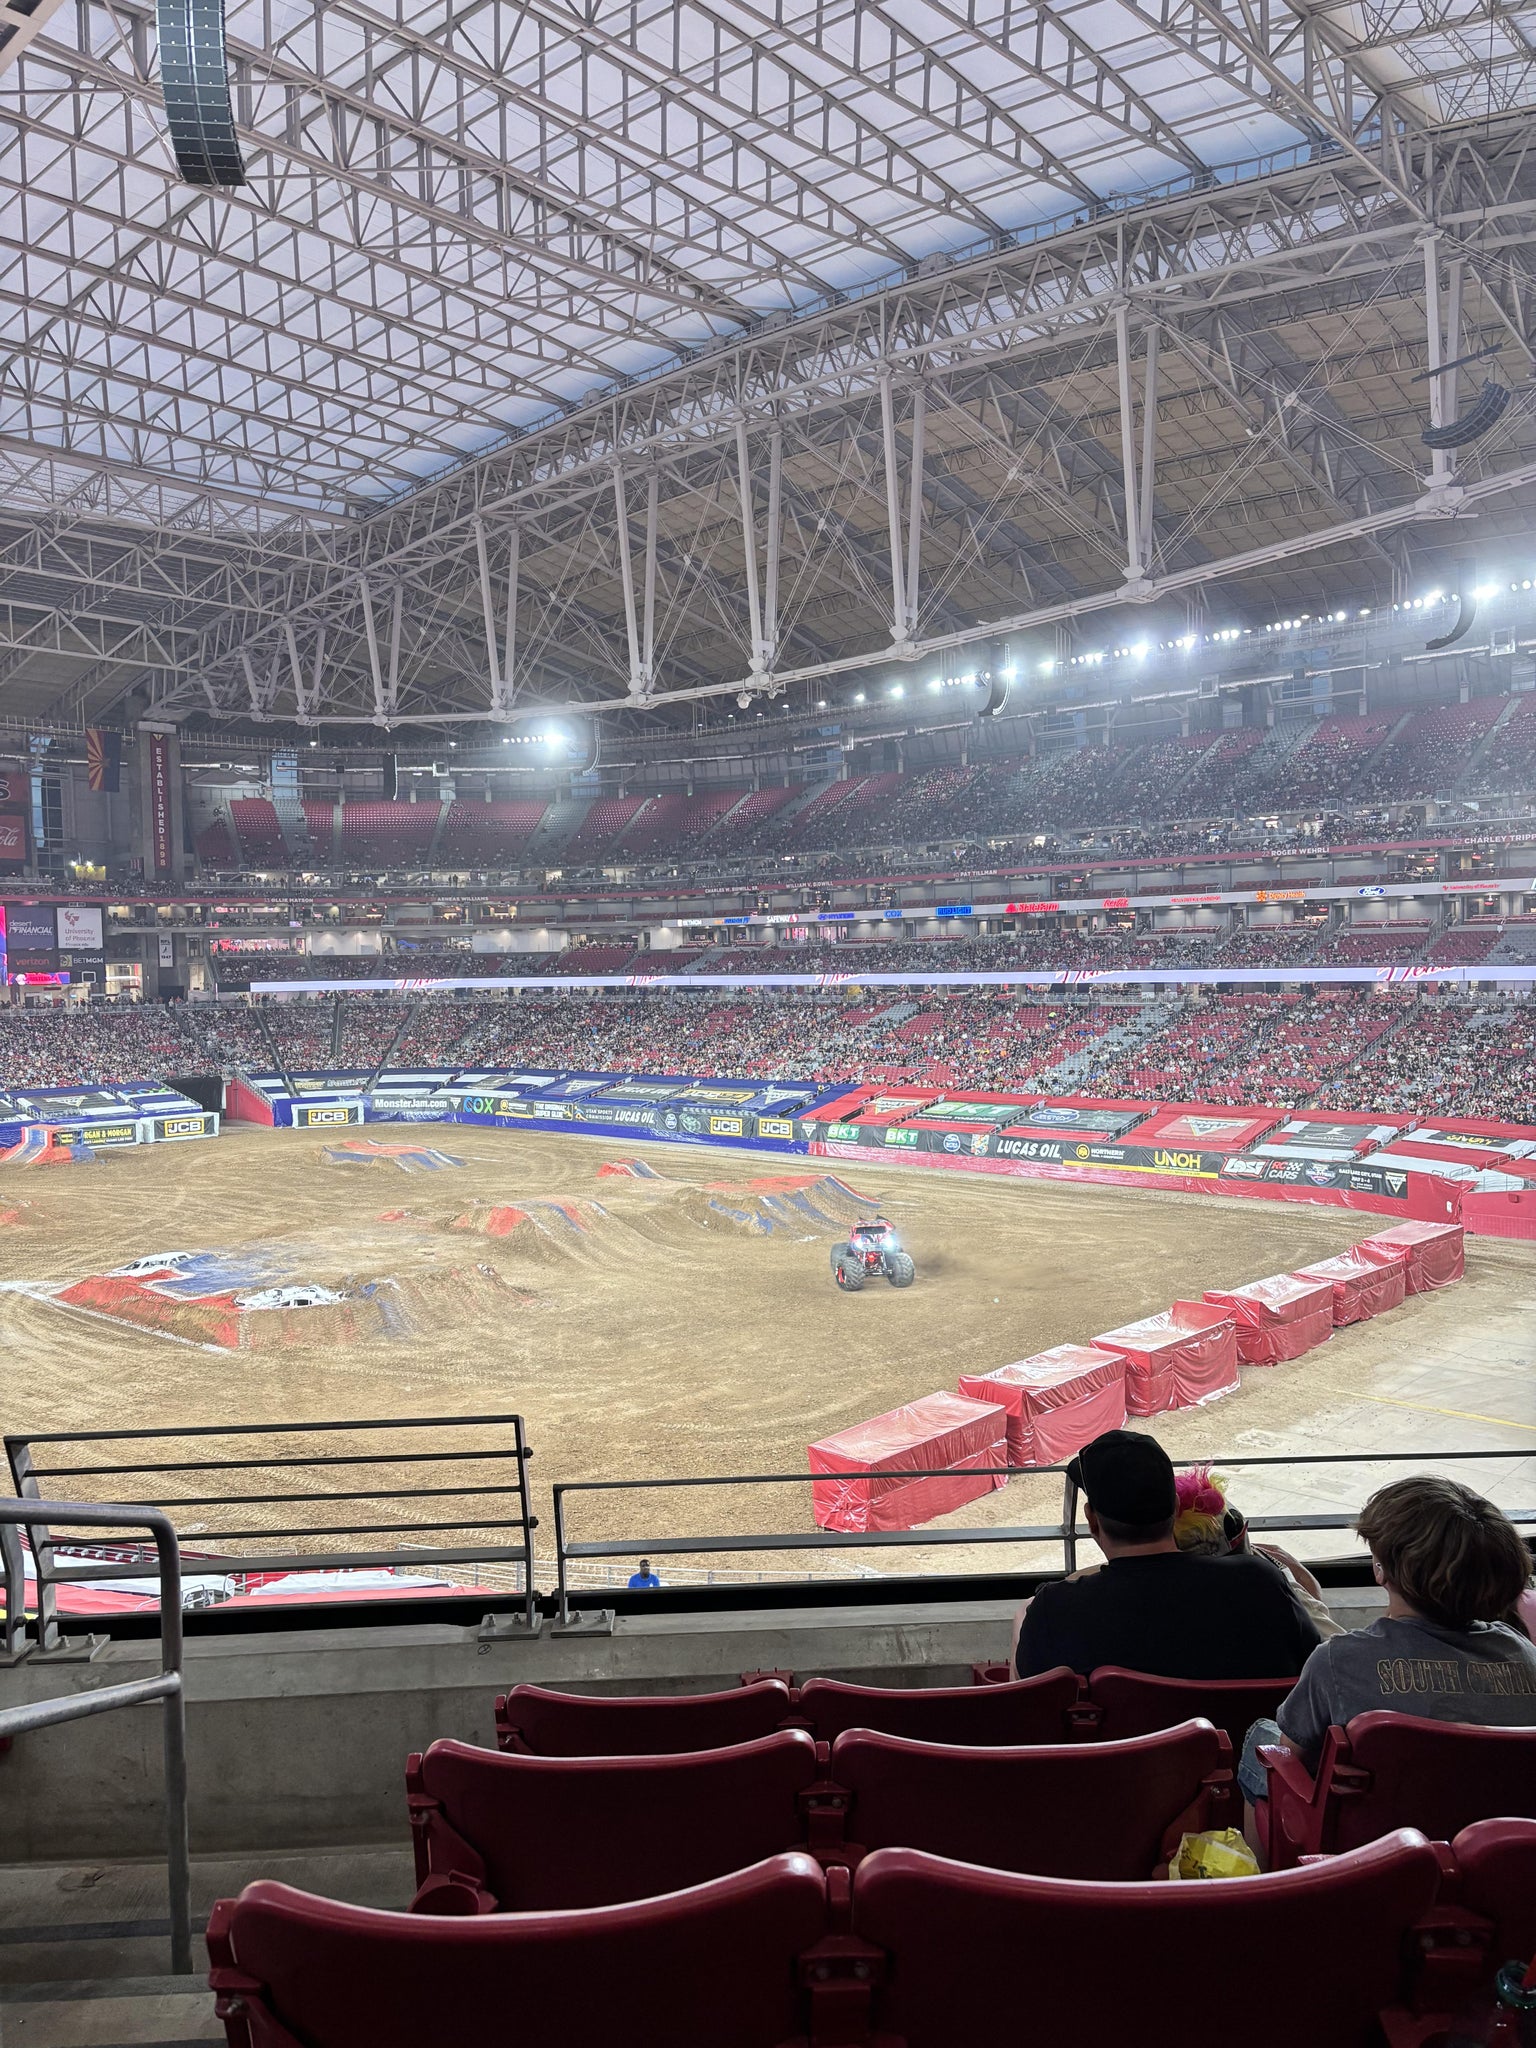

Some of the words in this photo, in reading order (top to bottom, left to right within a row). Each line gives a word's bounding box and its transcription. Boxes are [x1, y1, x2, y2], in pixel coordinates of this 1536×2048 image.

[155, 747, 165, 834] ESTABLISHED
[1464, 835, 1506, 844] CHARLEY
[1298, 847, 1330, 855] WEHRLI
[766, 915, 790, 923] SAFEWAY
[884, 910, 902, 918] COX
[16, 956, 49, 966] verizon
[374, 1099, 448, 1109] MonsterJam.com
[463, 1097, 494, 1114] COX
[311, 1111, 346, 1122] JCB
[615, 1110, 641, 1122] LUCAS
[641, 1112, 656, 1124] OIL
[168, 1121, 201, 1133] JCB
[713, 1120, 740, 1132] JCB
[762, 1122, 790, 1134] JCB
[828, 1124, 860, 1139] BKT
[886, 1128, 919, 1144] BKT
[997, 1139, 1039, 1157] LUCAS
[1039, 1143, 1061, 1159] OIL
[1091, 1148, 1125, 1156] NORTHERN
[1154, 1150, 1201, 1169] UNOH
[1271, 1161, 1287, 1170] RC
[1268, 1170, 1299, 1180] CARS
[1377, 1658, 1464, 1695] SOUTH
